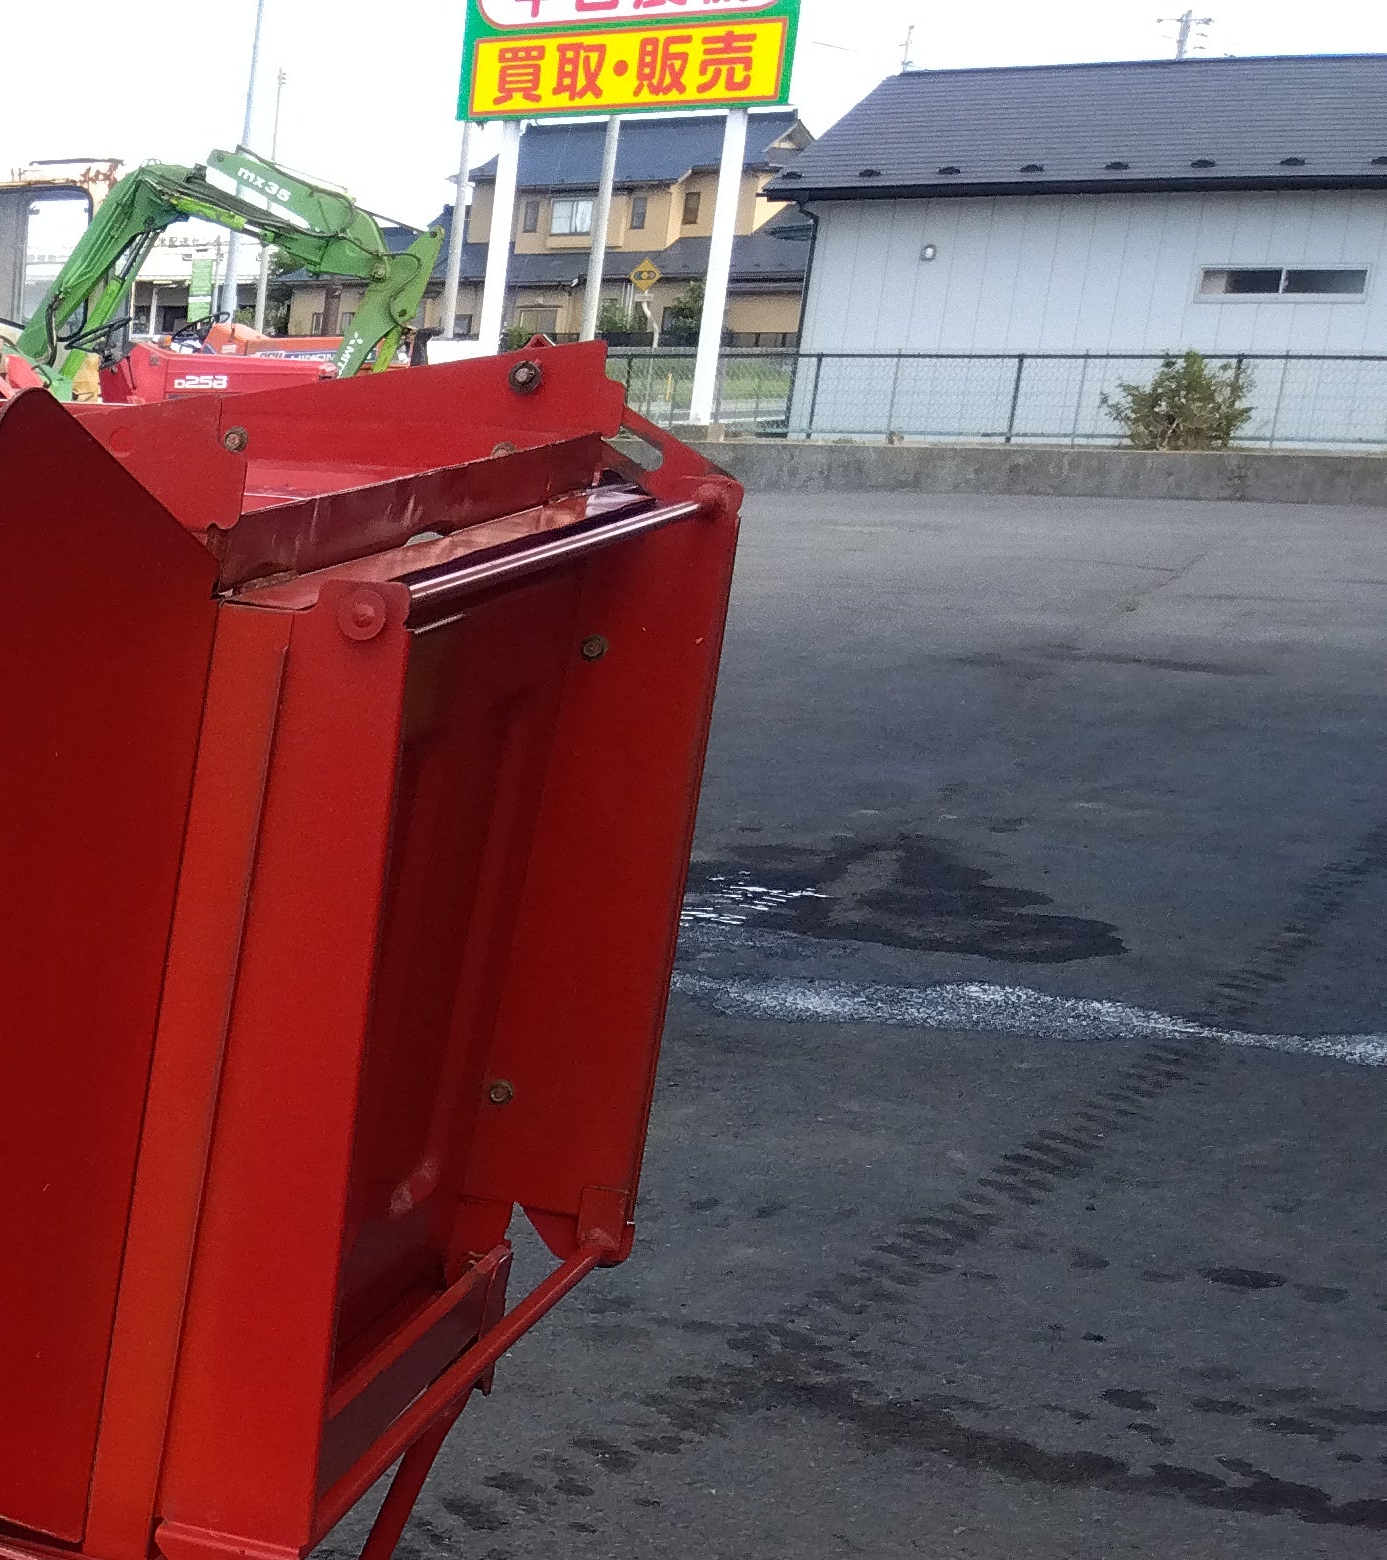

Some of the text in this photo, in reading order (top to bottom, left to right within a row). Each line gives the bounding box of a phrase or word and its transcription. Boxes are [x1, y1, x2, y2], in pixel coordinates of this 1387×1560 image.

[492, 30, 757, 106] 買取・販売
